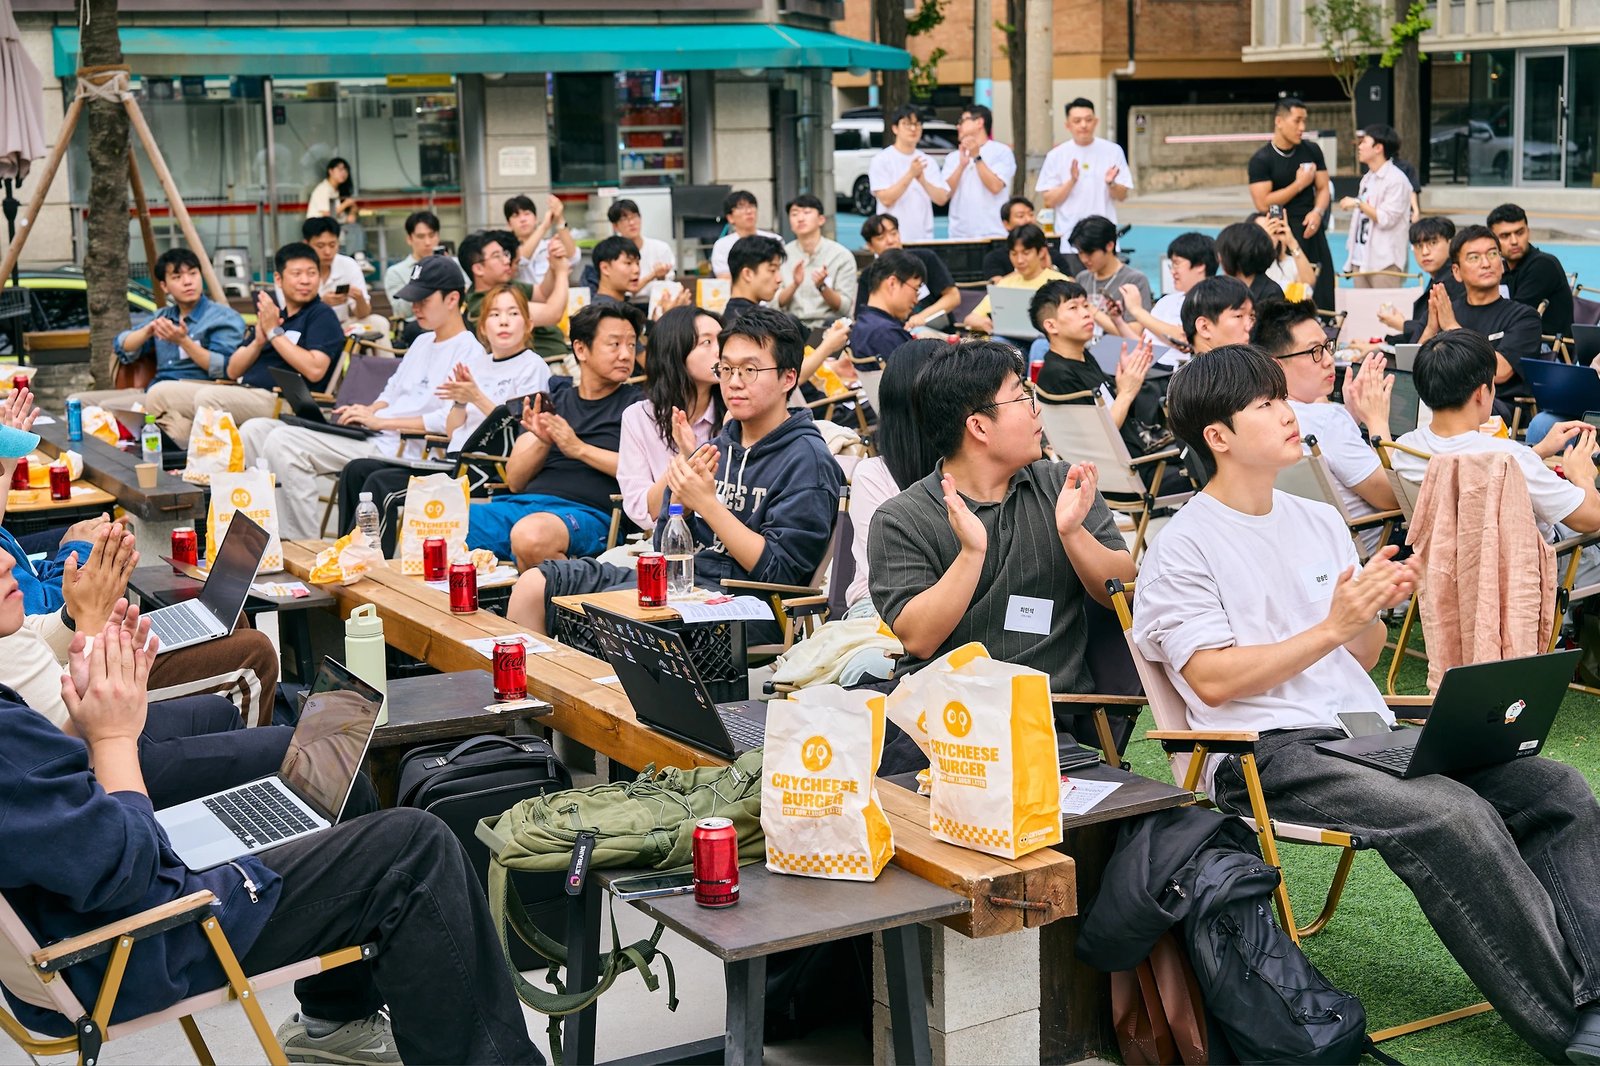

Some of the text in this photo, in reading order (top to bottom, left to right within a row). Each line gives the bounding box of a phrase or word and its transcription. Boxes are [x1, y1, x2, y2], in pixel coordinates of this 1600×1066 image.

[931, 739, 999, 762] CRYCHEESE
[771, 773, 859, 794] CRYCHEESE
[782, 791, 844, 808] BURGER
[575, 845, 586, 875] JETBRAINS
